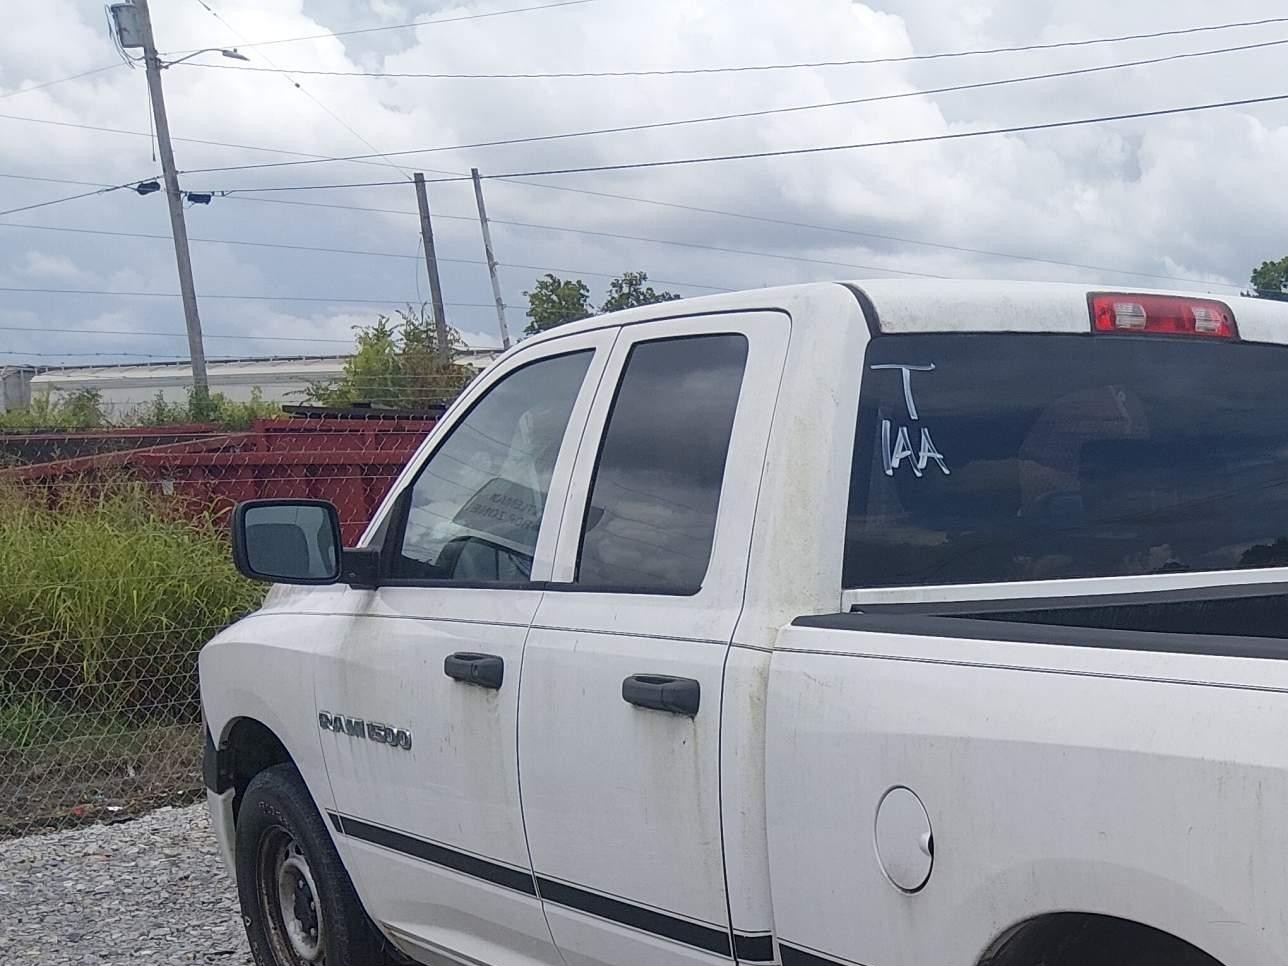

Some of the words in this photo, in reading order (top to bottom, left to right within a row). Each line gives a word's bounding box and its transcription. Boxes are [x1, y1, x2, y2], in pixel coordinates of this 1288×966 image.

[870, 363, 936, 420] T
[881, 419, 951, 477] IAA
[319, 710, 367, 739] RAM
[366, 721, 413, 751] 1500
